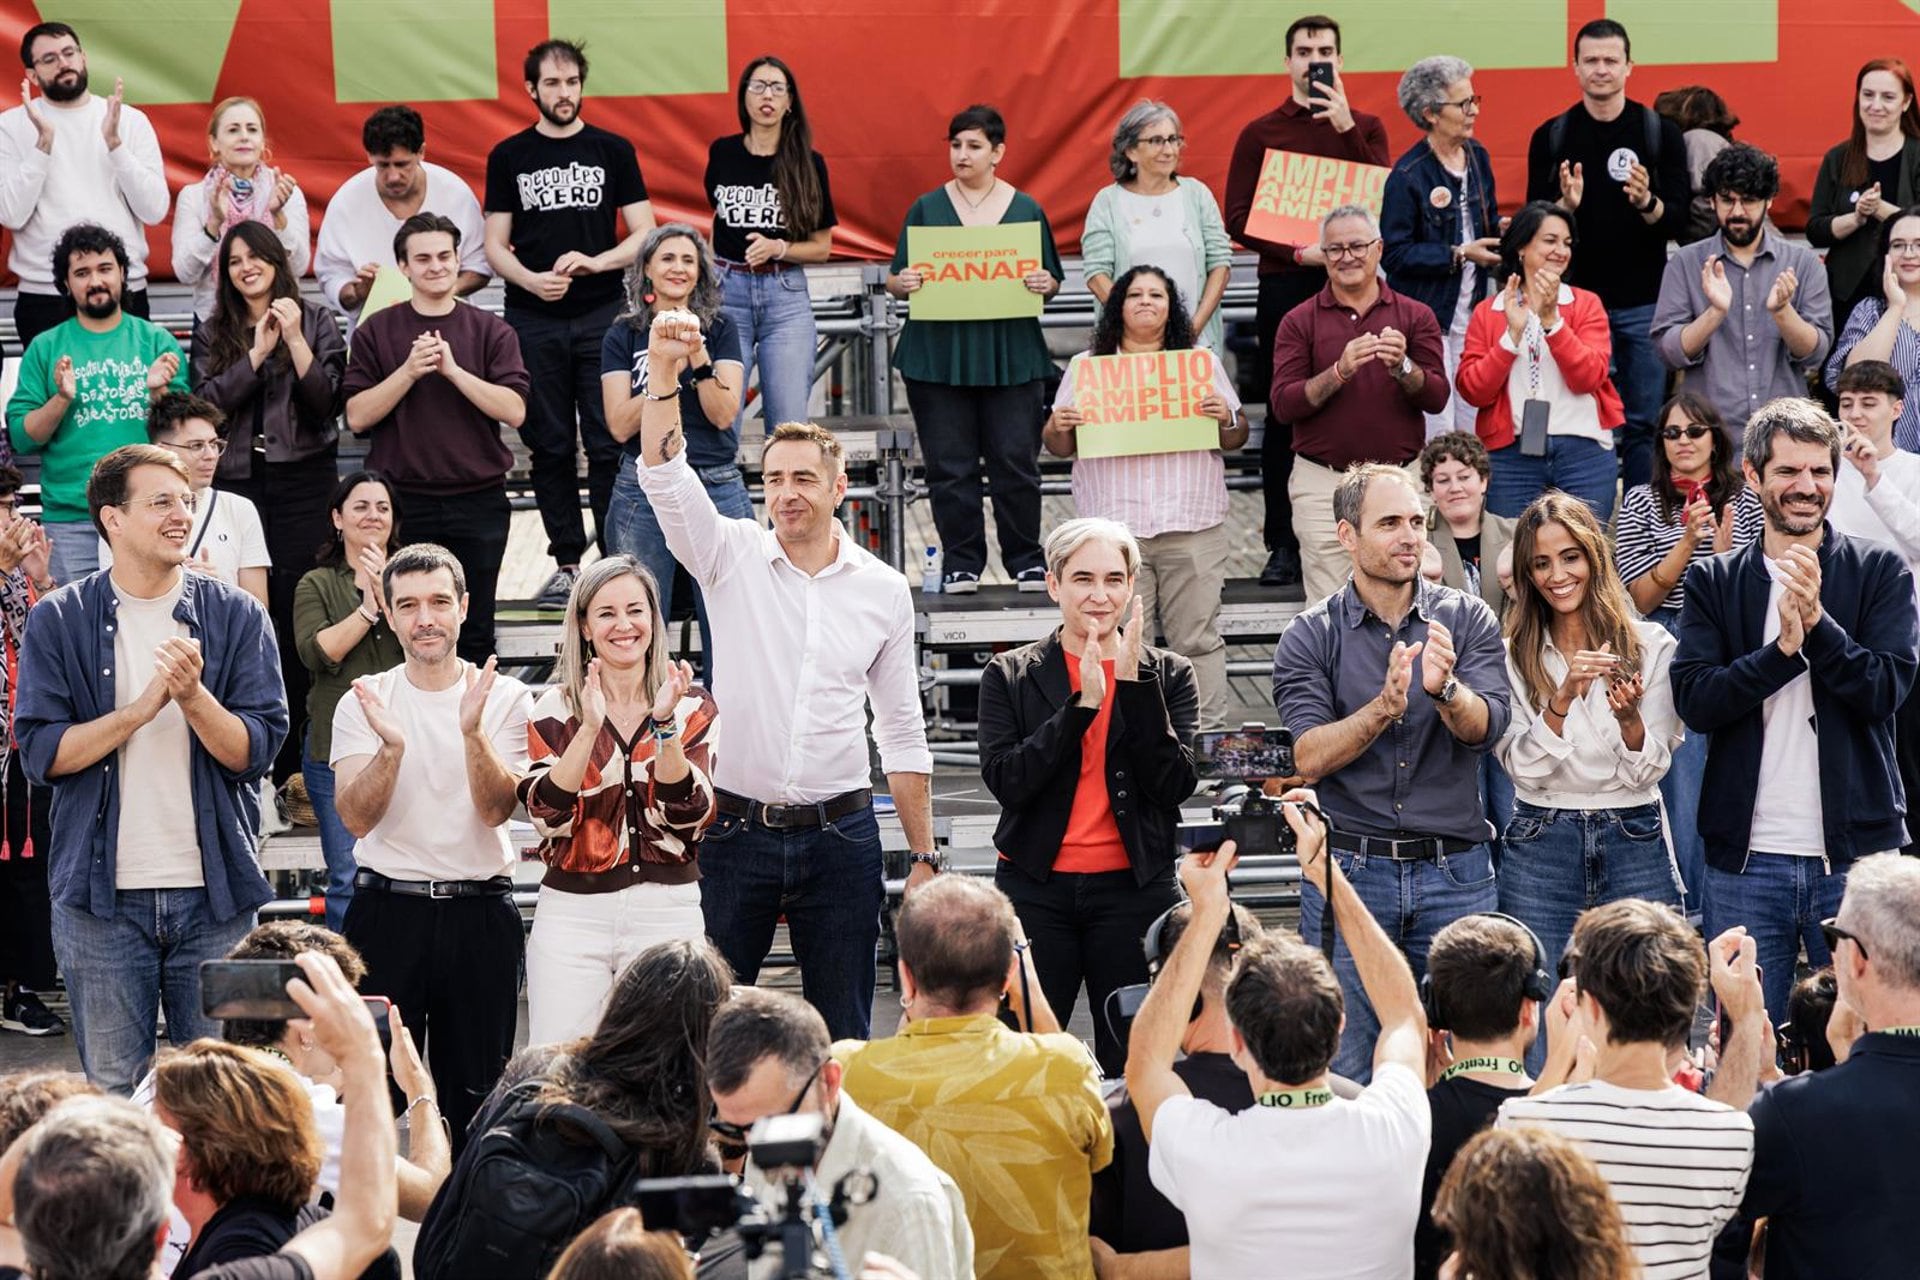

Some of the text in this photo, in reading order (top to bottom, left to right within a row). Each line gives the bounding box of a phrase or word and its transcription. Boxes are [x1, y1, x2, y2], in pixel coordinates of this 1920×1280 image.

[517, 162, 604, 211] Recortes
[1263, 151, 1388, 199] AMPLIO
[539, 185, 602, 211] CERO
[932, 248, 1018, 259] crecer para
[1076, 350, 1213, 391] AMPLIO
[1079, 383, 1214, 407] AMPLIO
[943, 631, 967, 640] VICO
